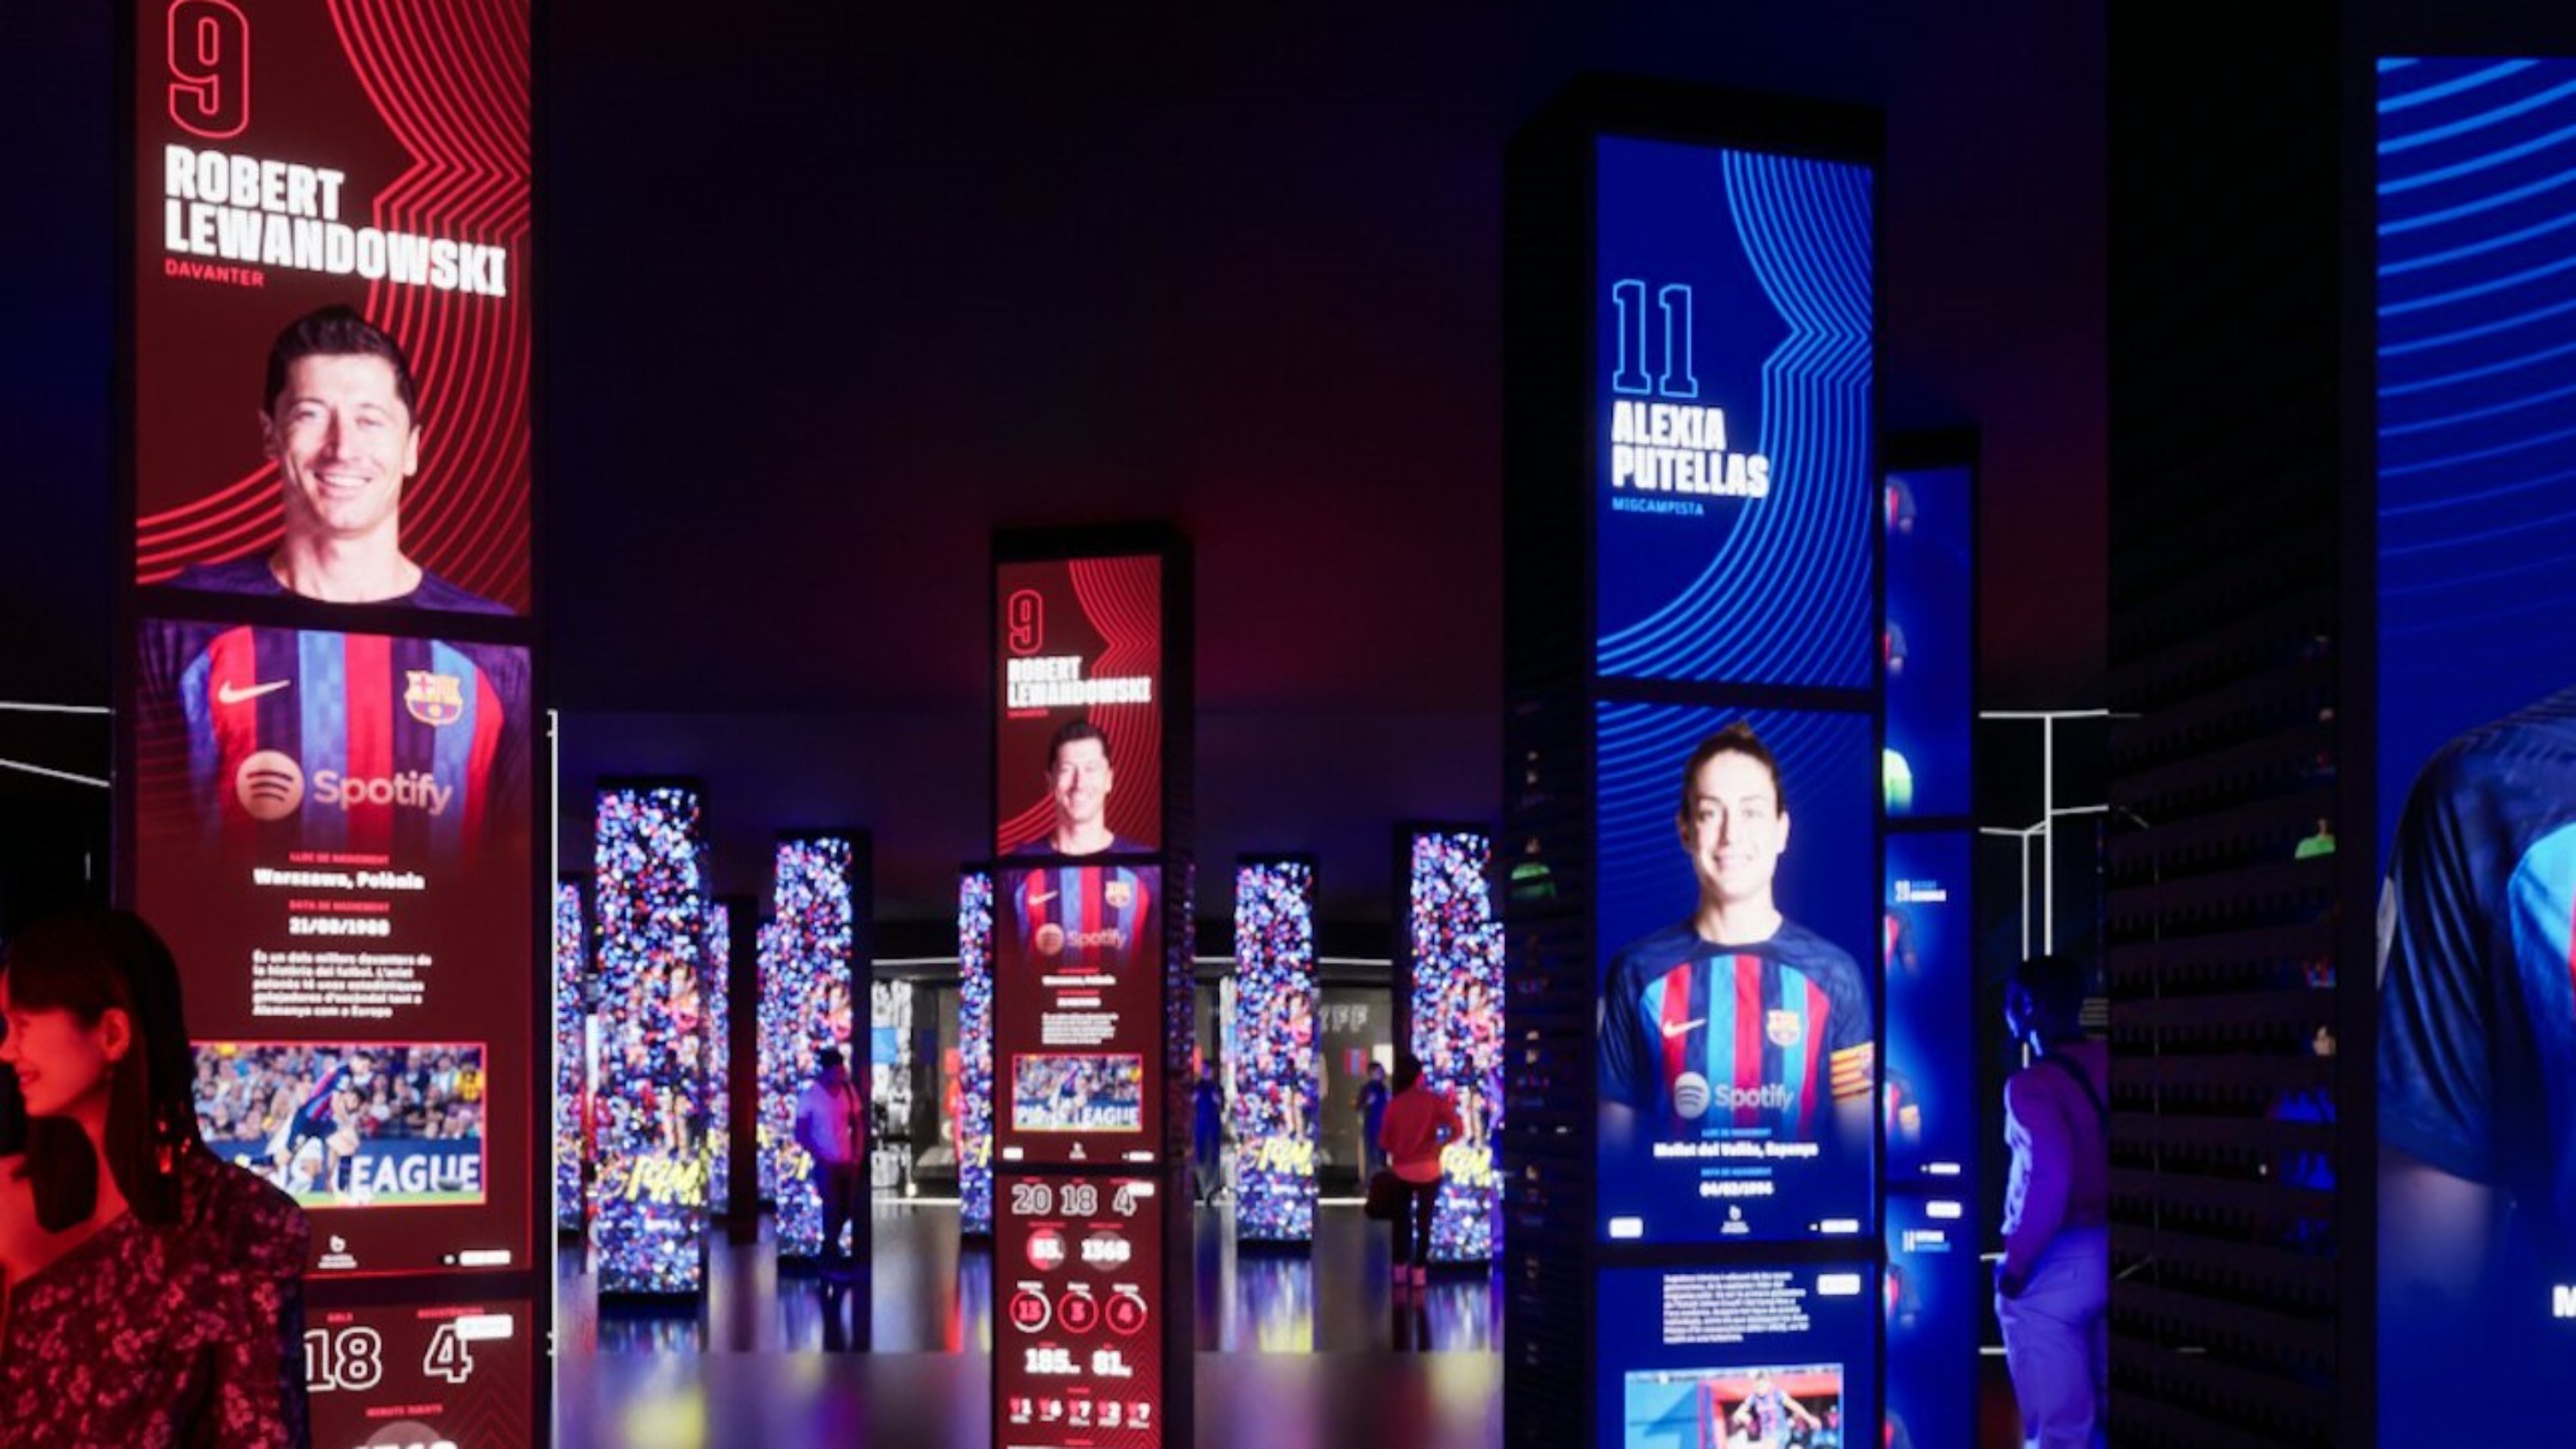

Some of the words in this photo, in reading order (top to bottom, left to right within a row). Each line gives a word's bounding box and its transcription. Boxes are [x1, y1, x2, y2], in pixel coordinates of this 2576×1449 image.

[168, 0, 249, 139] 9
[165, 144, 344, 221] ROBERT
[165, 198, 507, 296] LEWANDOWSKI
[165, 259, 264, 288] DAVANTER
[1613, 278, 1698, 399] 11
[1612, 399, 1727, 451] ALEXIA
[1612, 443, 1770, 499] PUTELLAS
[1009, 589, 1043, 654] 9
[1006, 656, 1082, 682] ROBERT
[1007, 677, 1151, 707] LEWANDOWSKI
[313, 770, 452, 815] Spotify
[1067, 928, 1127, 950] Spotify
[1715, 1084, 1794, 1113] Spotify
[1011, 1184, 1052, 1215] 20
[1060, 1184, 1098, 1216] 18
[1112, 1185, 1137, 1216] 4
[304, 1327, 382, 1391] 18
[423, 1323, 474, 1383] 4
